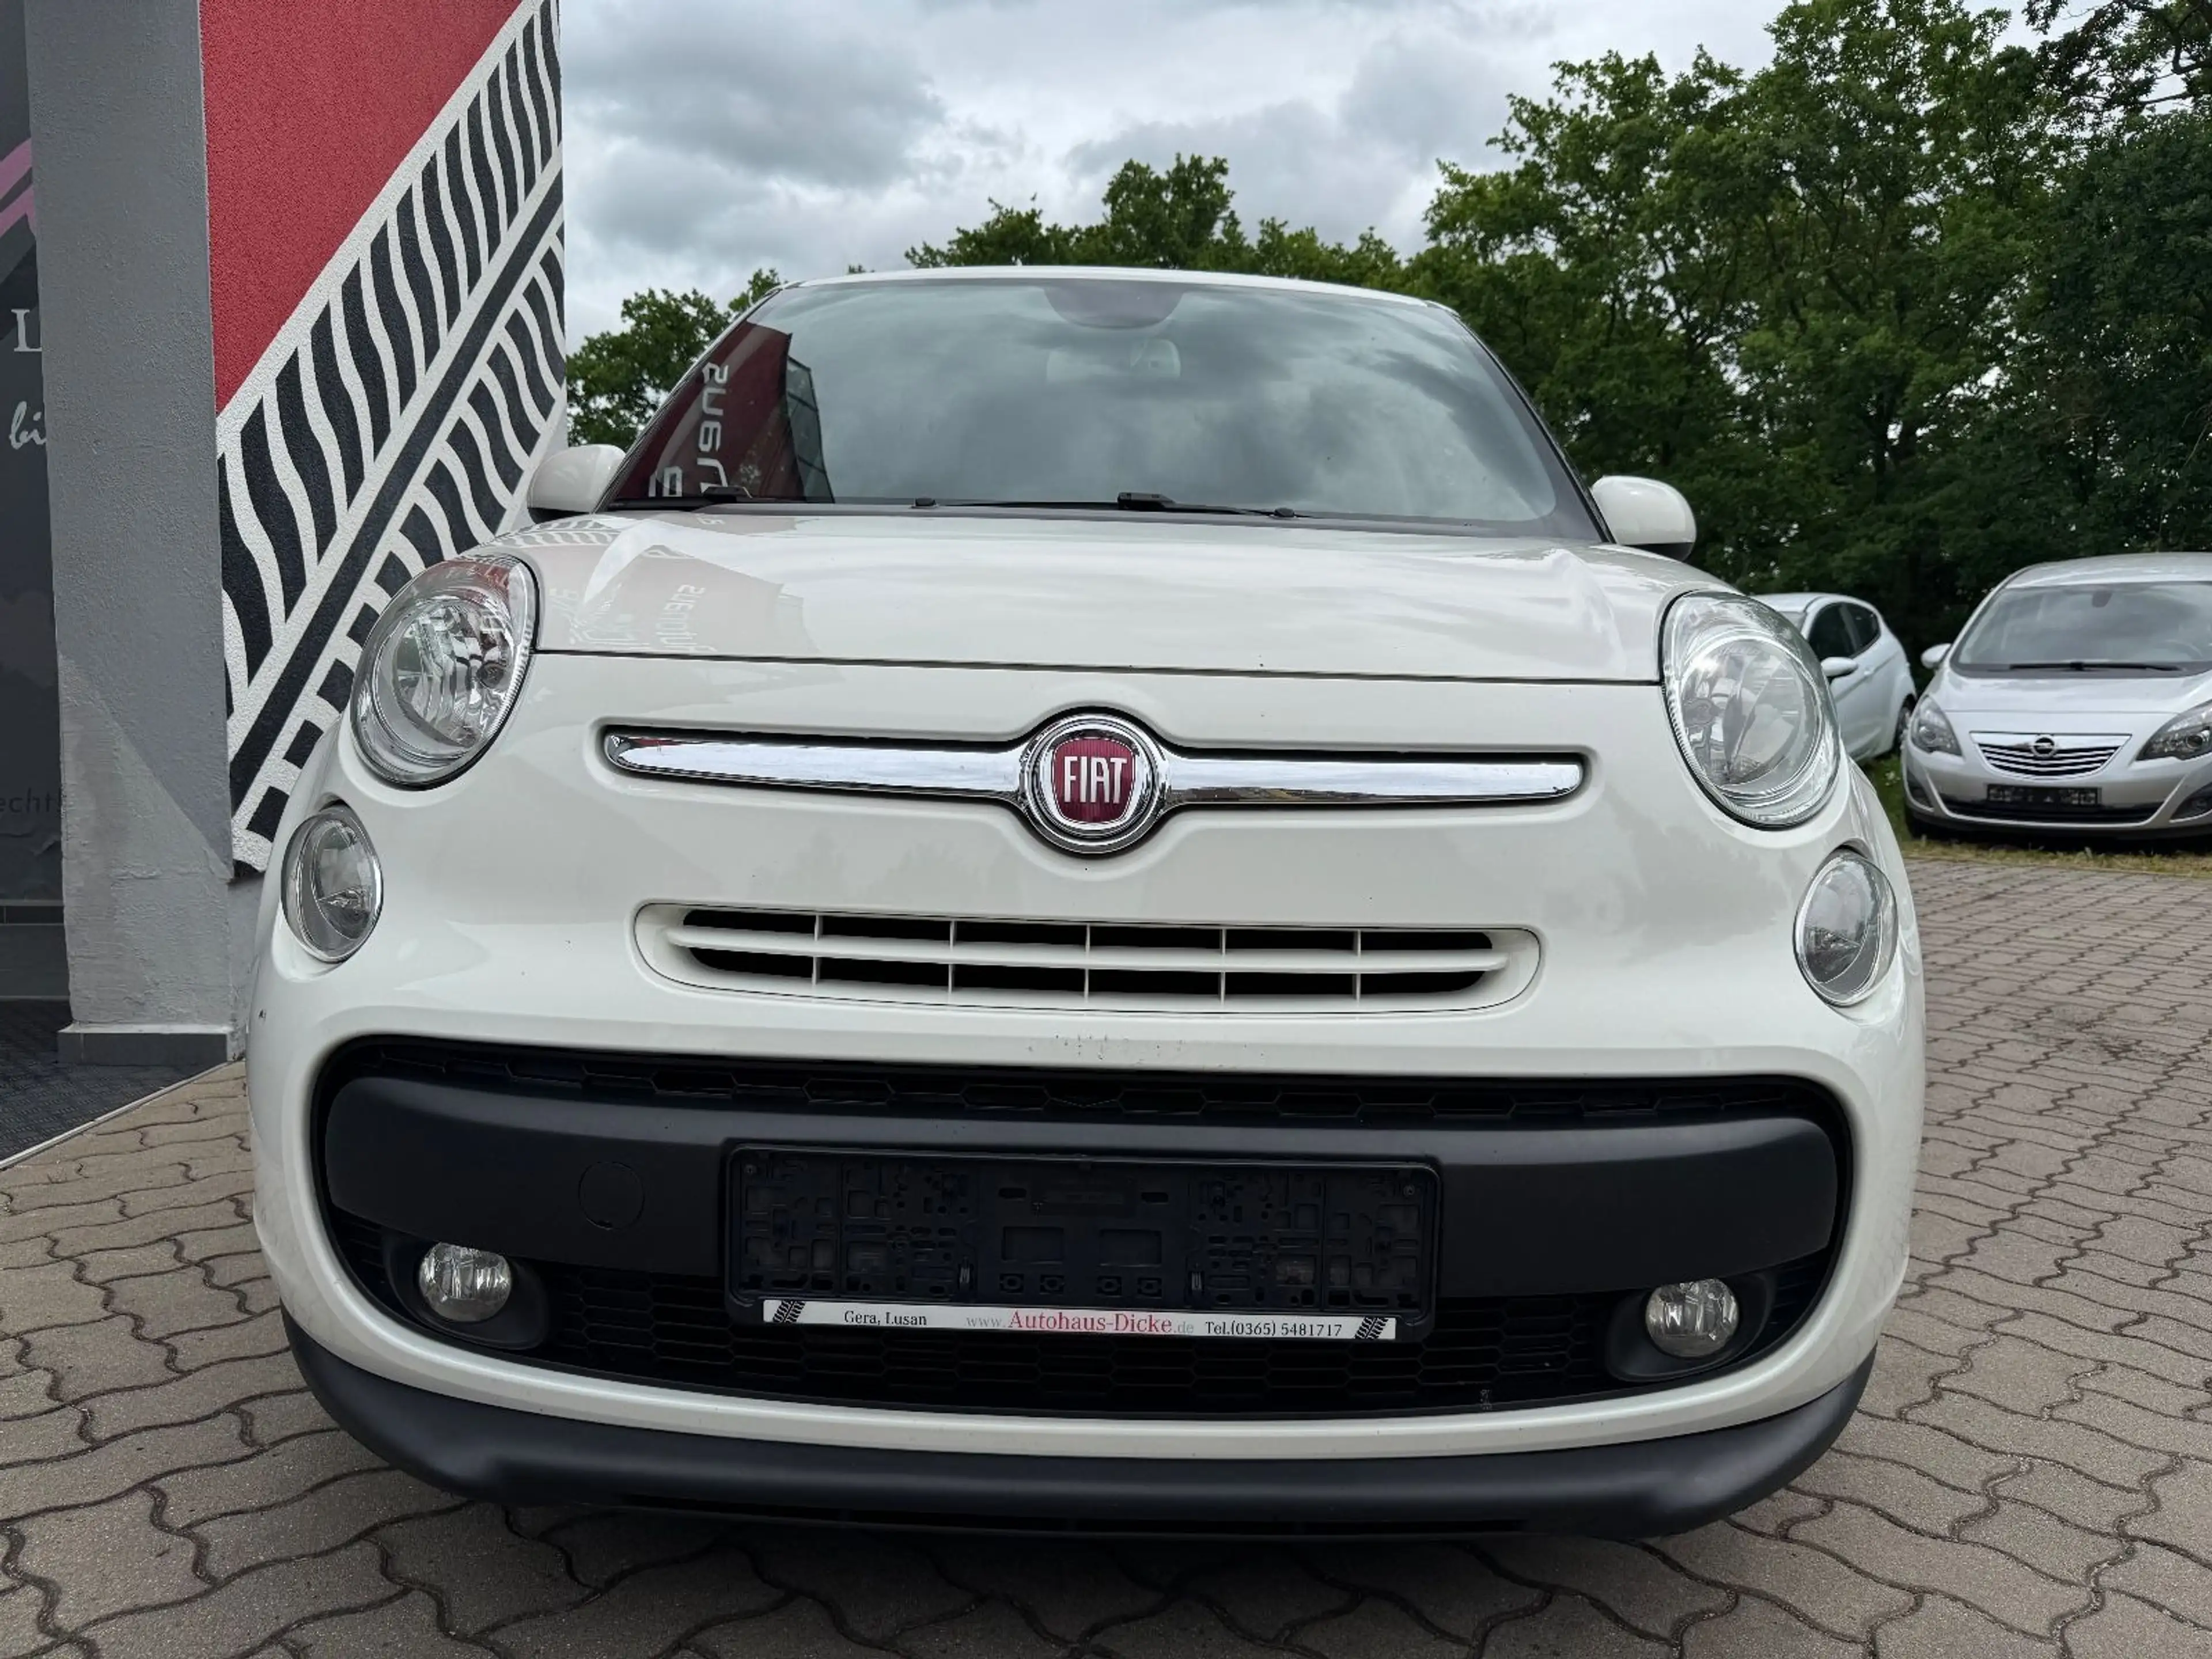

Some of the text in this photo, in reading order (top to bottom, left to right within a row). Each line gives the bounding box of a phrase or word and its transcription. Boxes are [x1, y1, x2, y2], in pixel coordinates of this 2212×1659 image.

[1064, 756, 1127, 804] FIAT
[844, 1310, 881, 1326] Gera,
[885, 1311, 927, 1326] Lusan
[1281, 1323, 1342, 1336] 5481717
